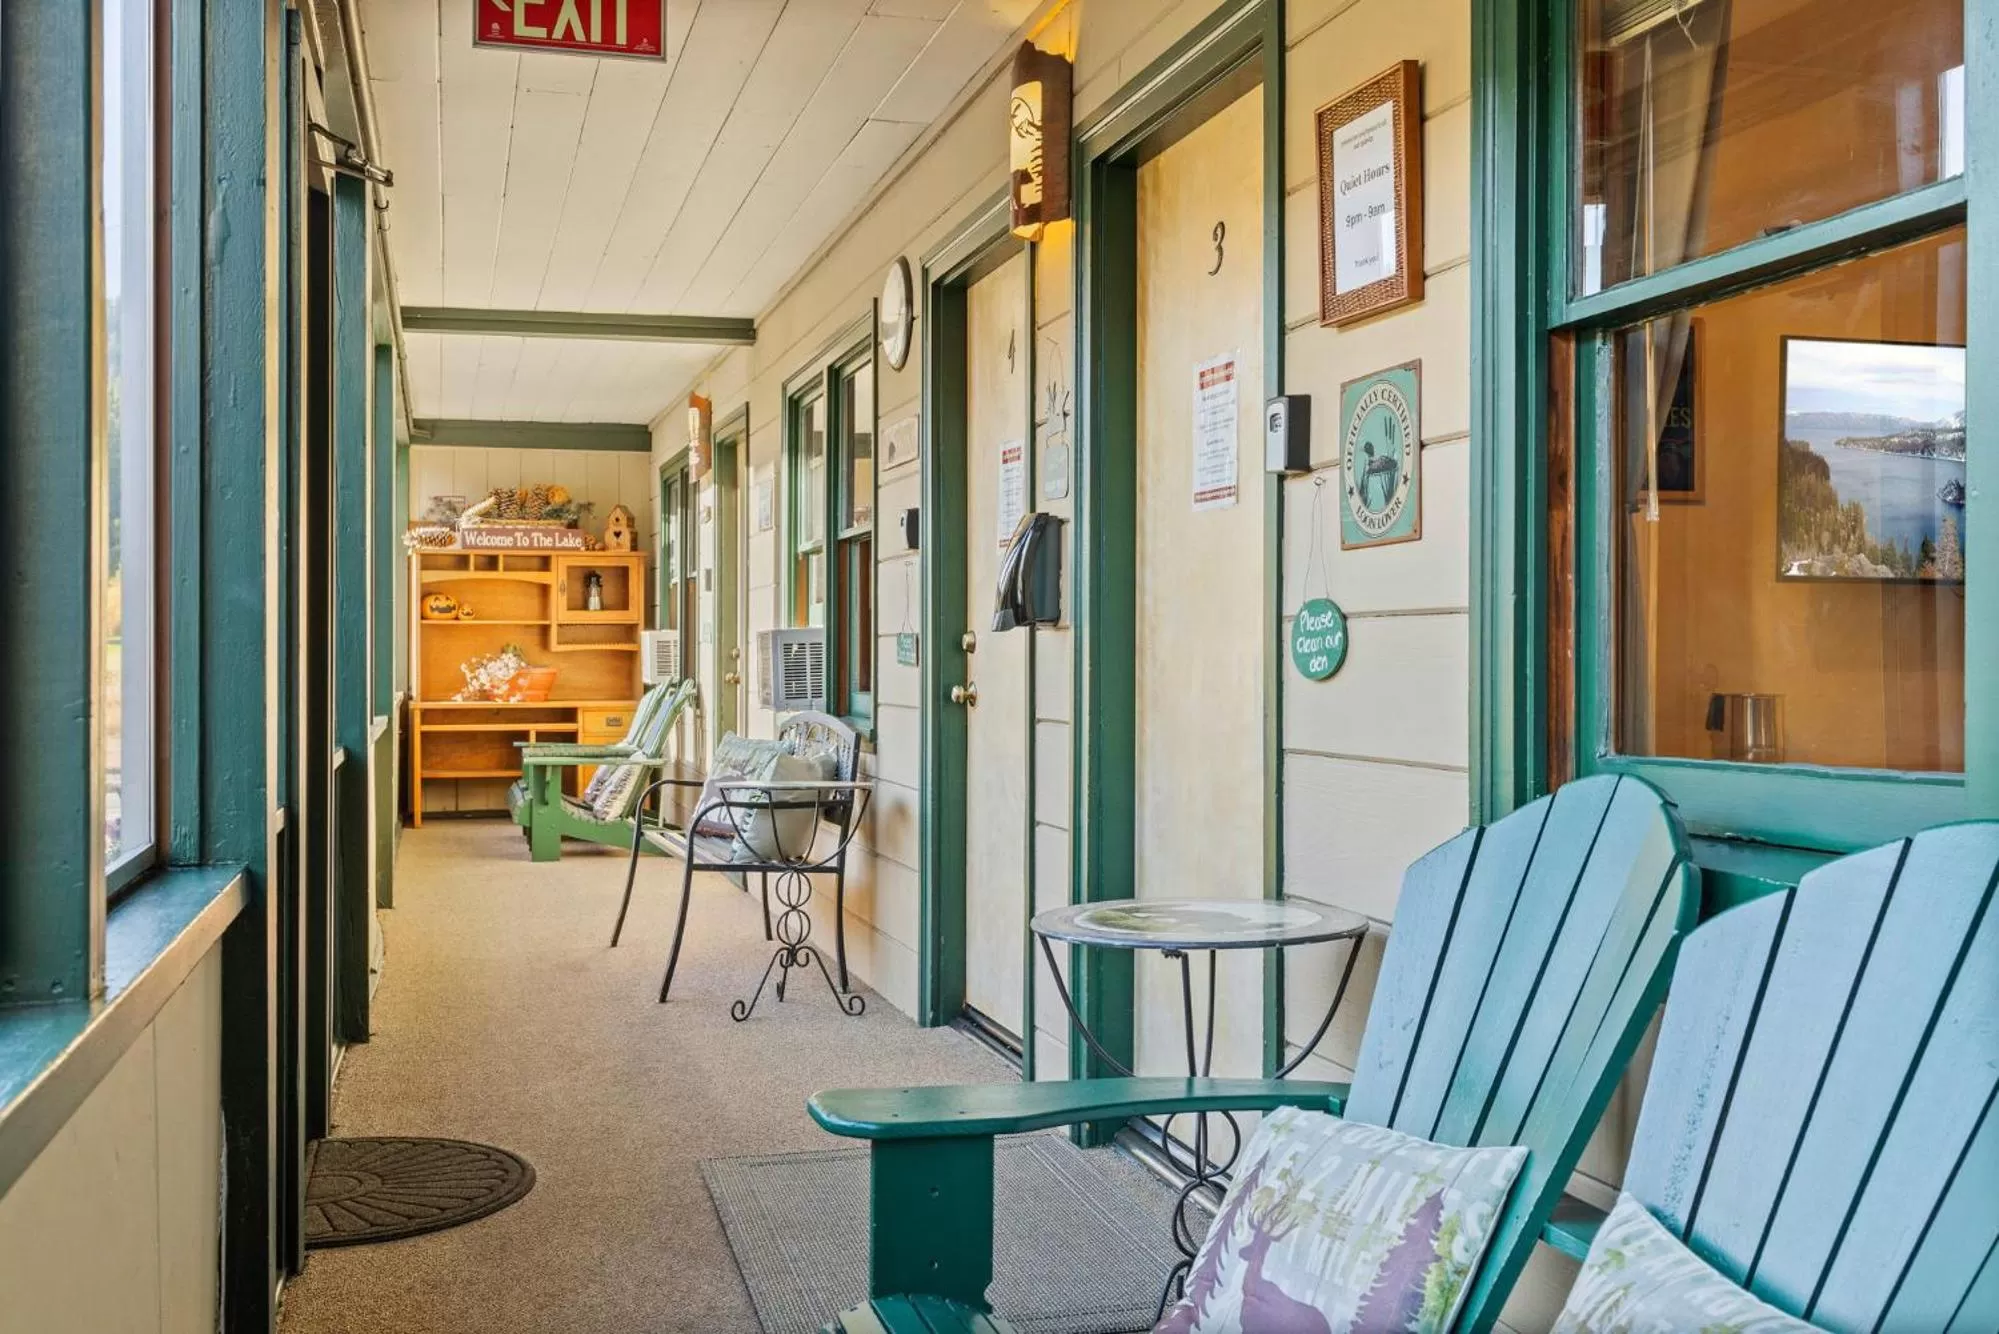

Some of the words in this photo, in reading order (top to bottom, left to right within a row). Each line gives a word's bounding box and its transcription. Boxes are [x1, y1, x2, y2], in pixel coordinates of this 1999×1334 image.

[1340, 174, 1362, 196] Quiet
[1364, 164, 1391, 184] Hours
[1345, 213, 1363, 229] 9pm
[1368, 203, 1386, 218] 9am
[1208, 221, 1226, 276] 3
[1346, 389, 1379, 471] OFFICIALLY
[1381, 388, 1411, 457] CERTIFIED
[1378, 497, 1402, 528] LOVER
[464, 530, 513, 547] Welcome
[514, 531, 530, 547] To
[531, 532, 553, 547] The
[555, 532, 583, 548] Lake
[1300, 610, 1334, 633] Please
